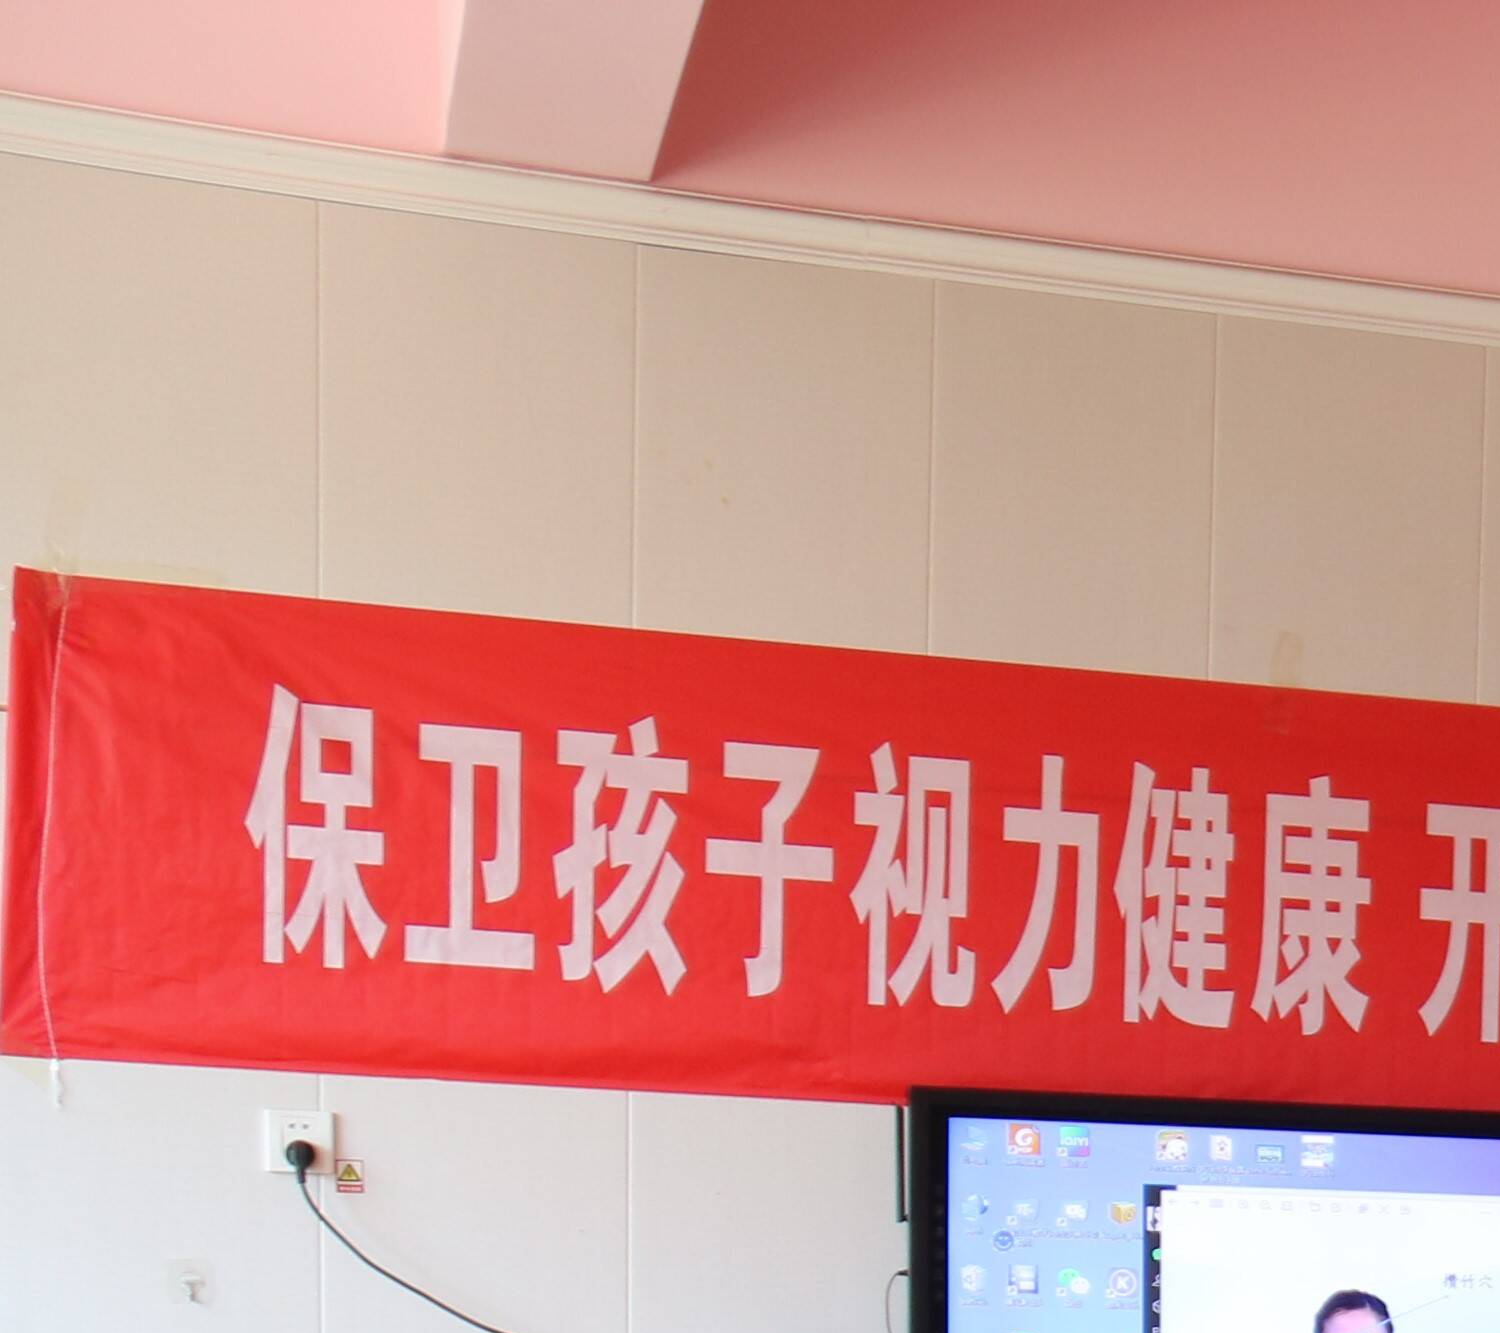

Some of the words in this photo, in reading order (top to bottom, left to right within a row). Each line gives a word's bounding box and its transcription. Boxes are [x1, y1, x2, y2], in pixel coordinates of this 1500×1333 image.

[243, 682, 1371, 1036] 保卫孩子视力健康
